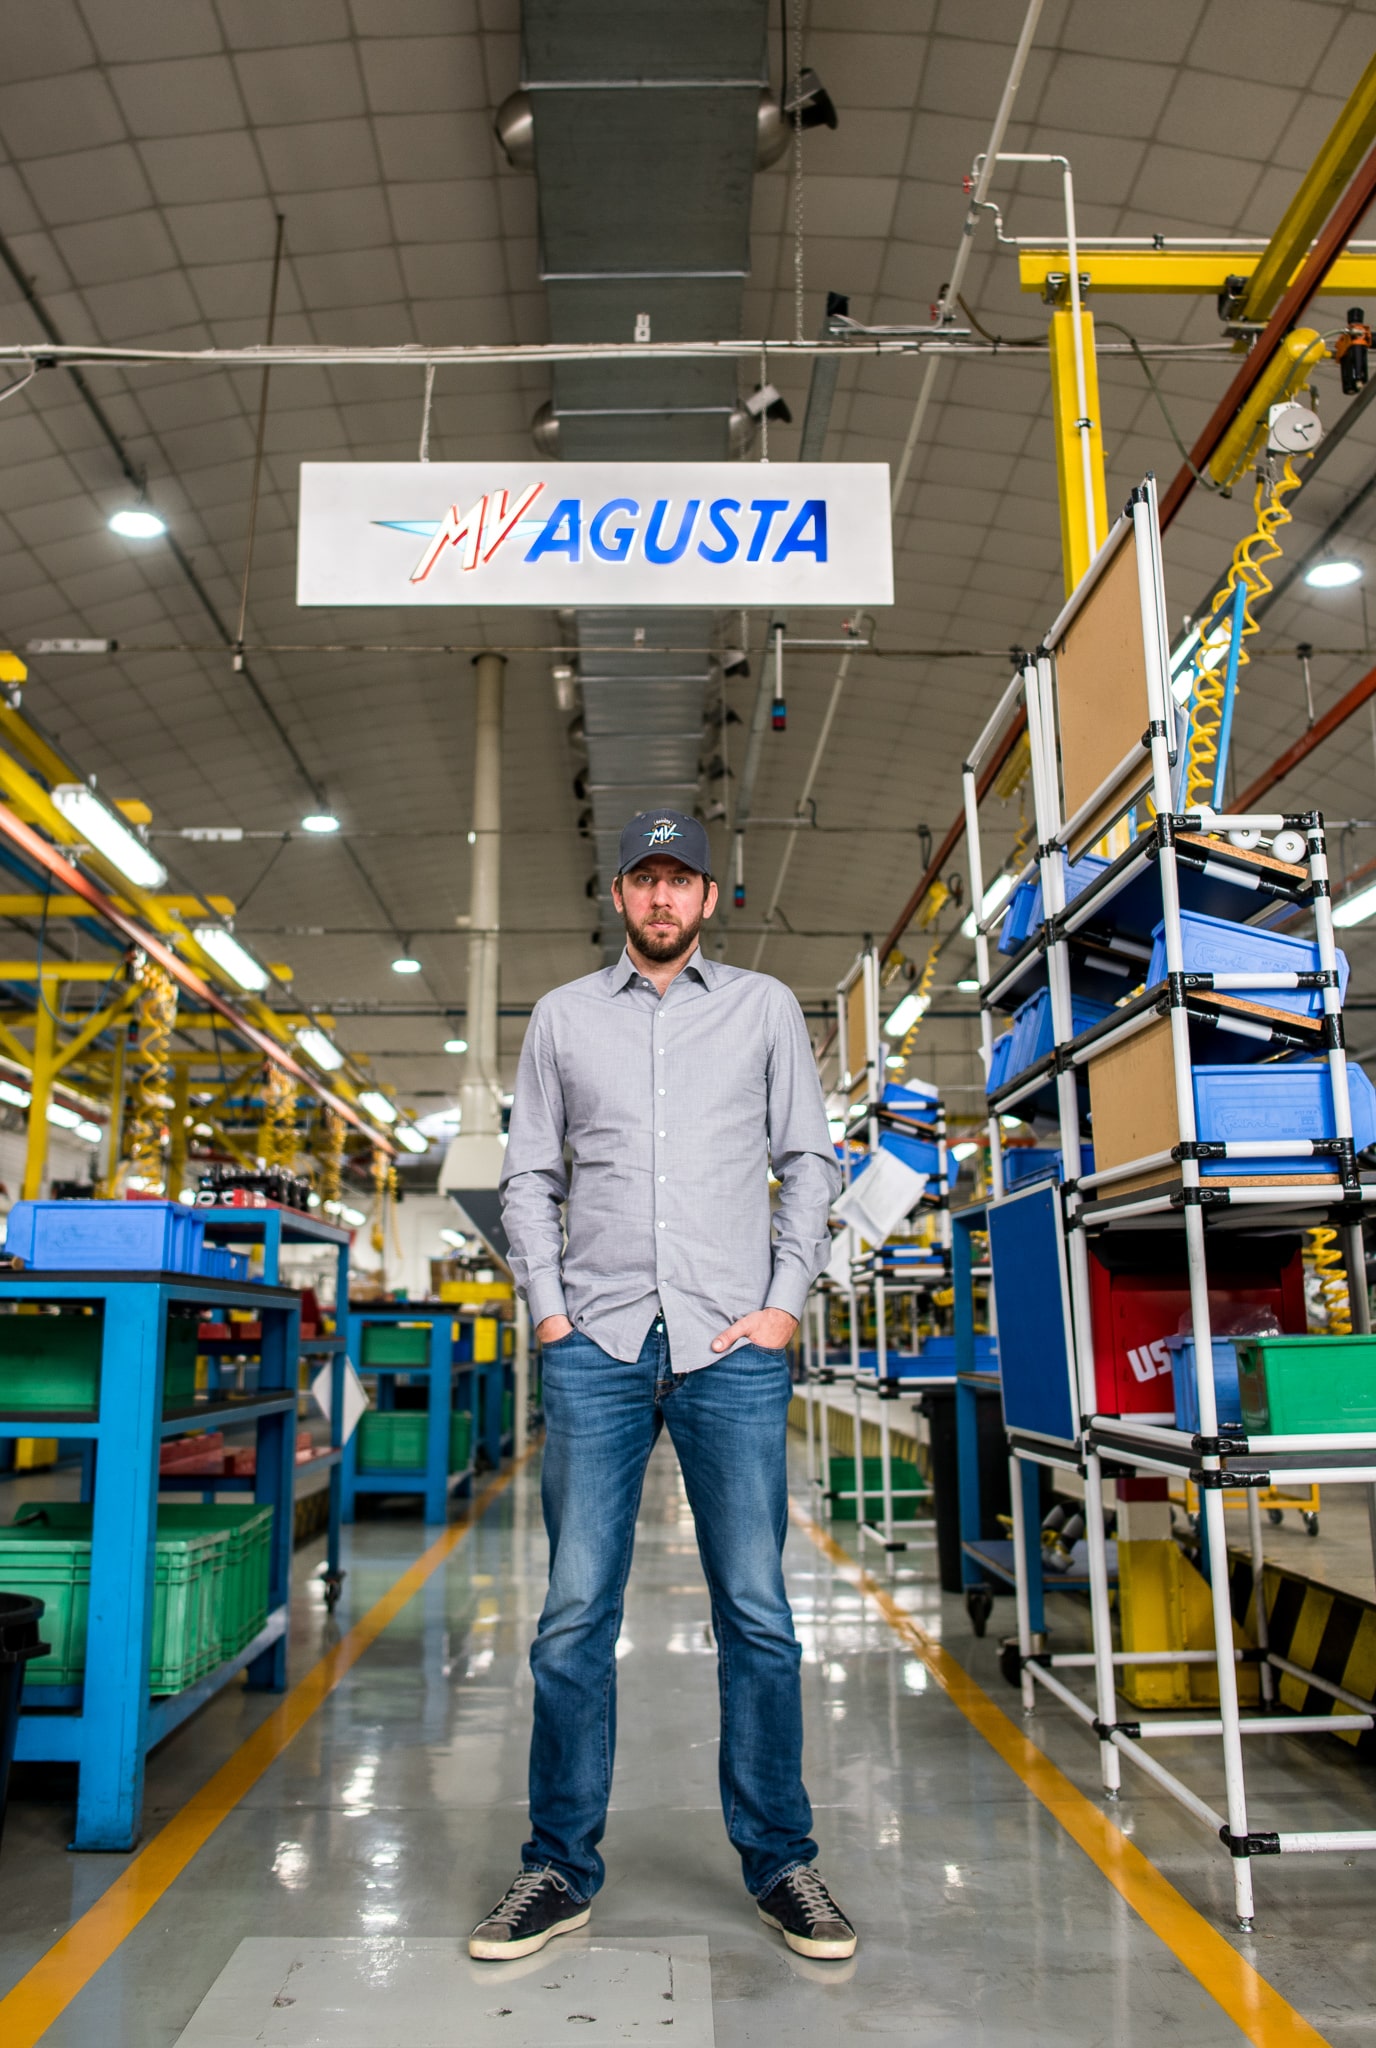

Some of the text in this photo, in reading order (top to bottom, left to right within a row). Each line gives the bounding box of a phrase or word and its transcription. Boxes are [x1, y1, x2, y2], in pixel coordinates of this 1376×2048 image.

[409, 481, 828, 584] MV AGUSTA
[648, 823, 677, 847] MV
[1126, 1334, 1178, 1383] US
